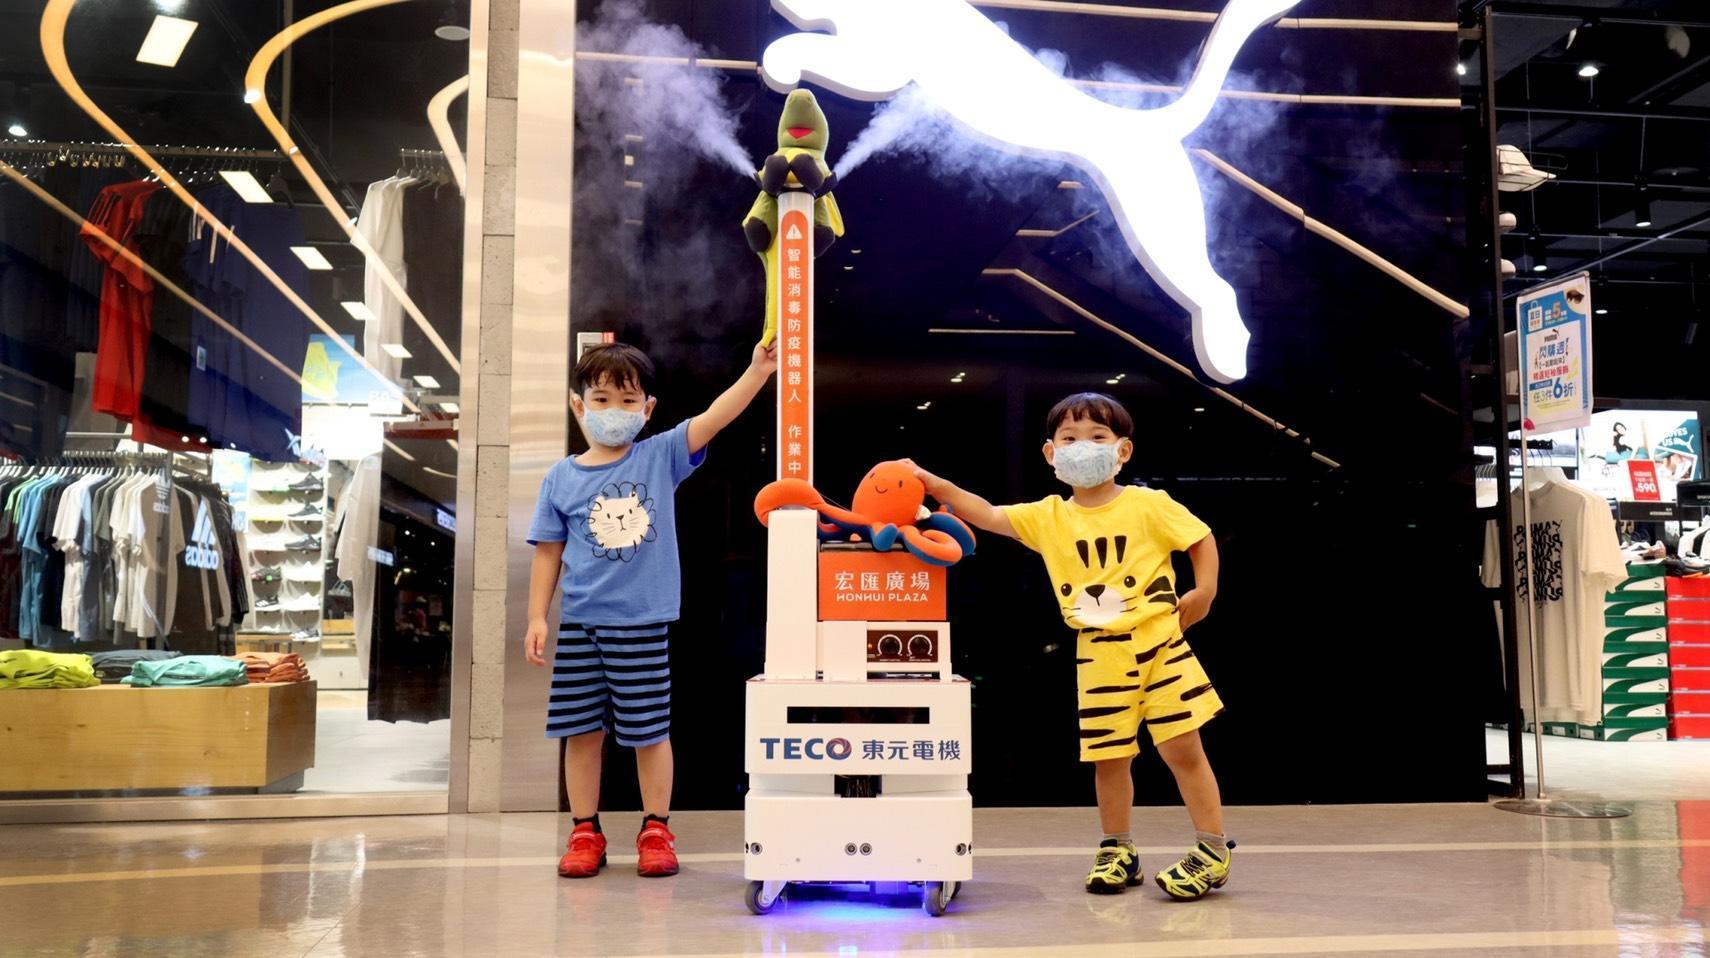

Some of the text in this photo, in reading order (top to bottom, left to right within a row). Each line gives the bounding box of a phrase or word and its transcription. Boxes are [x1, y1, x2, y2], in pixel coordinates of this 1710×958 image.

[787, 248, 802, 474] 智能消毒防疫機器人 作業中
[834, 571, 930, 591] 宏匯廣場
[836, 593, 928, 602] HONHUI PLAZA
[760, 737, 961, 761] TECO 東元電機
